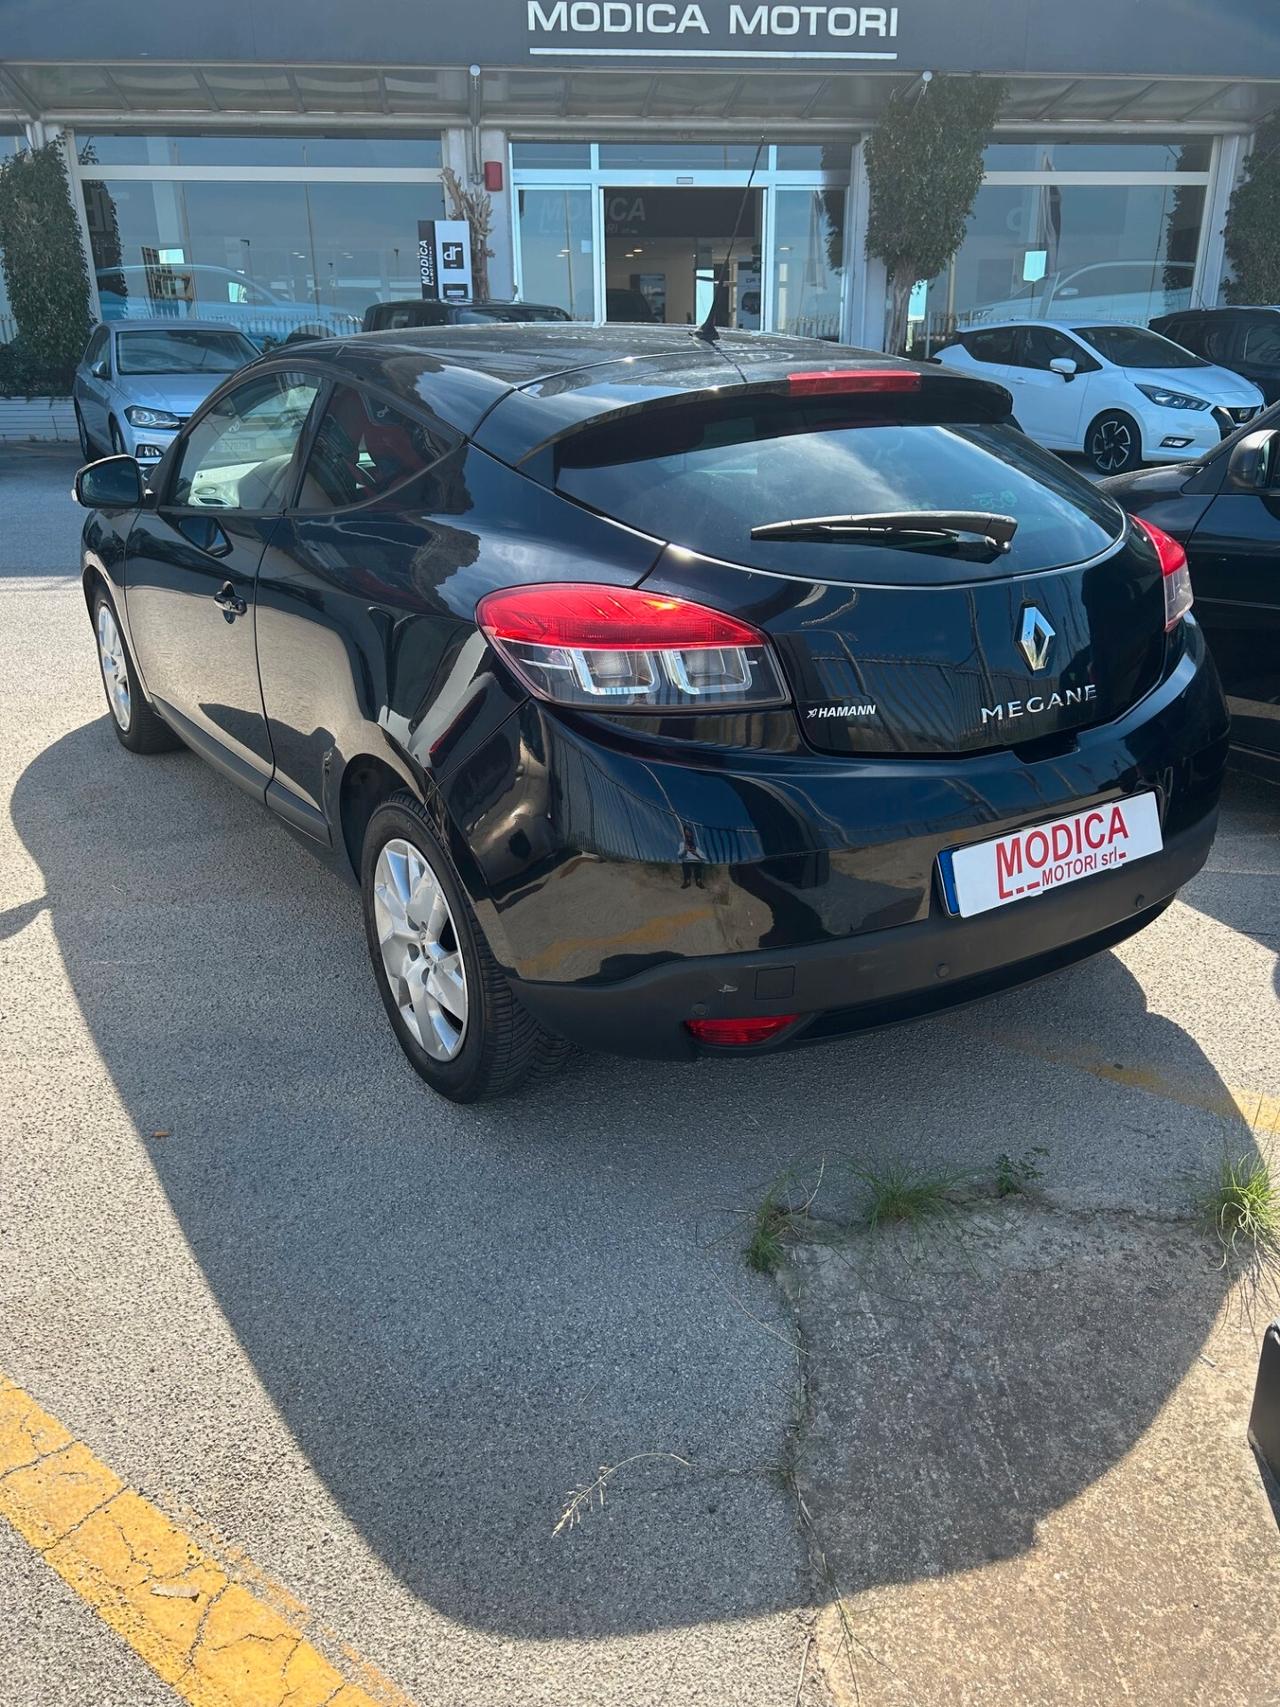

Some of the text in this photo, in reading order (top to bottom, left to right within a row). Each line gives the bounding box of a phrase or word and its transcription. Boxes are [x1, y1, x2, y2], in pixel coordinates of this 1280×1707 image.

[527, 0, 898, 37] MODICA MOTORI
[818, 704, 877, 718] HAMANN
[981, 684, 1098, 724] MEGANE
[995, 806, 1129, 882] MODICA
[1041, 846, 1118, 887] MOTORI srl
